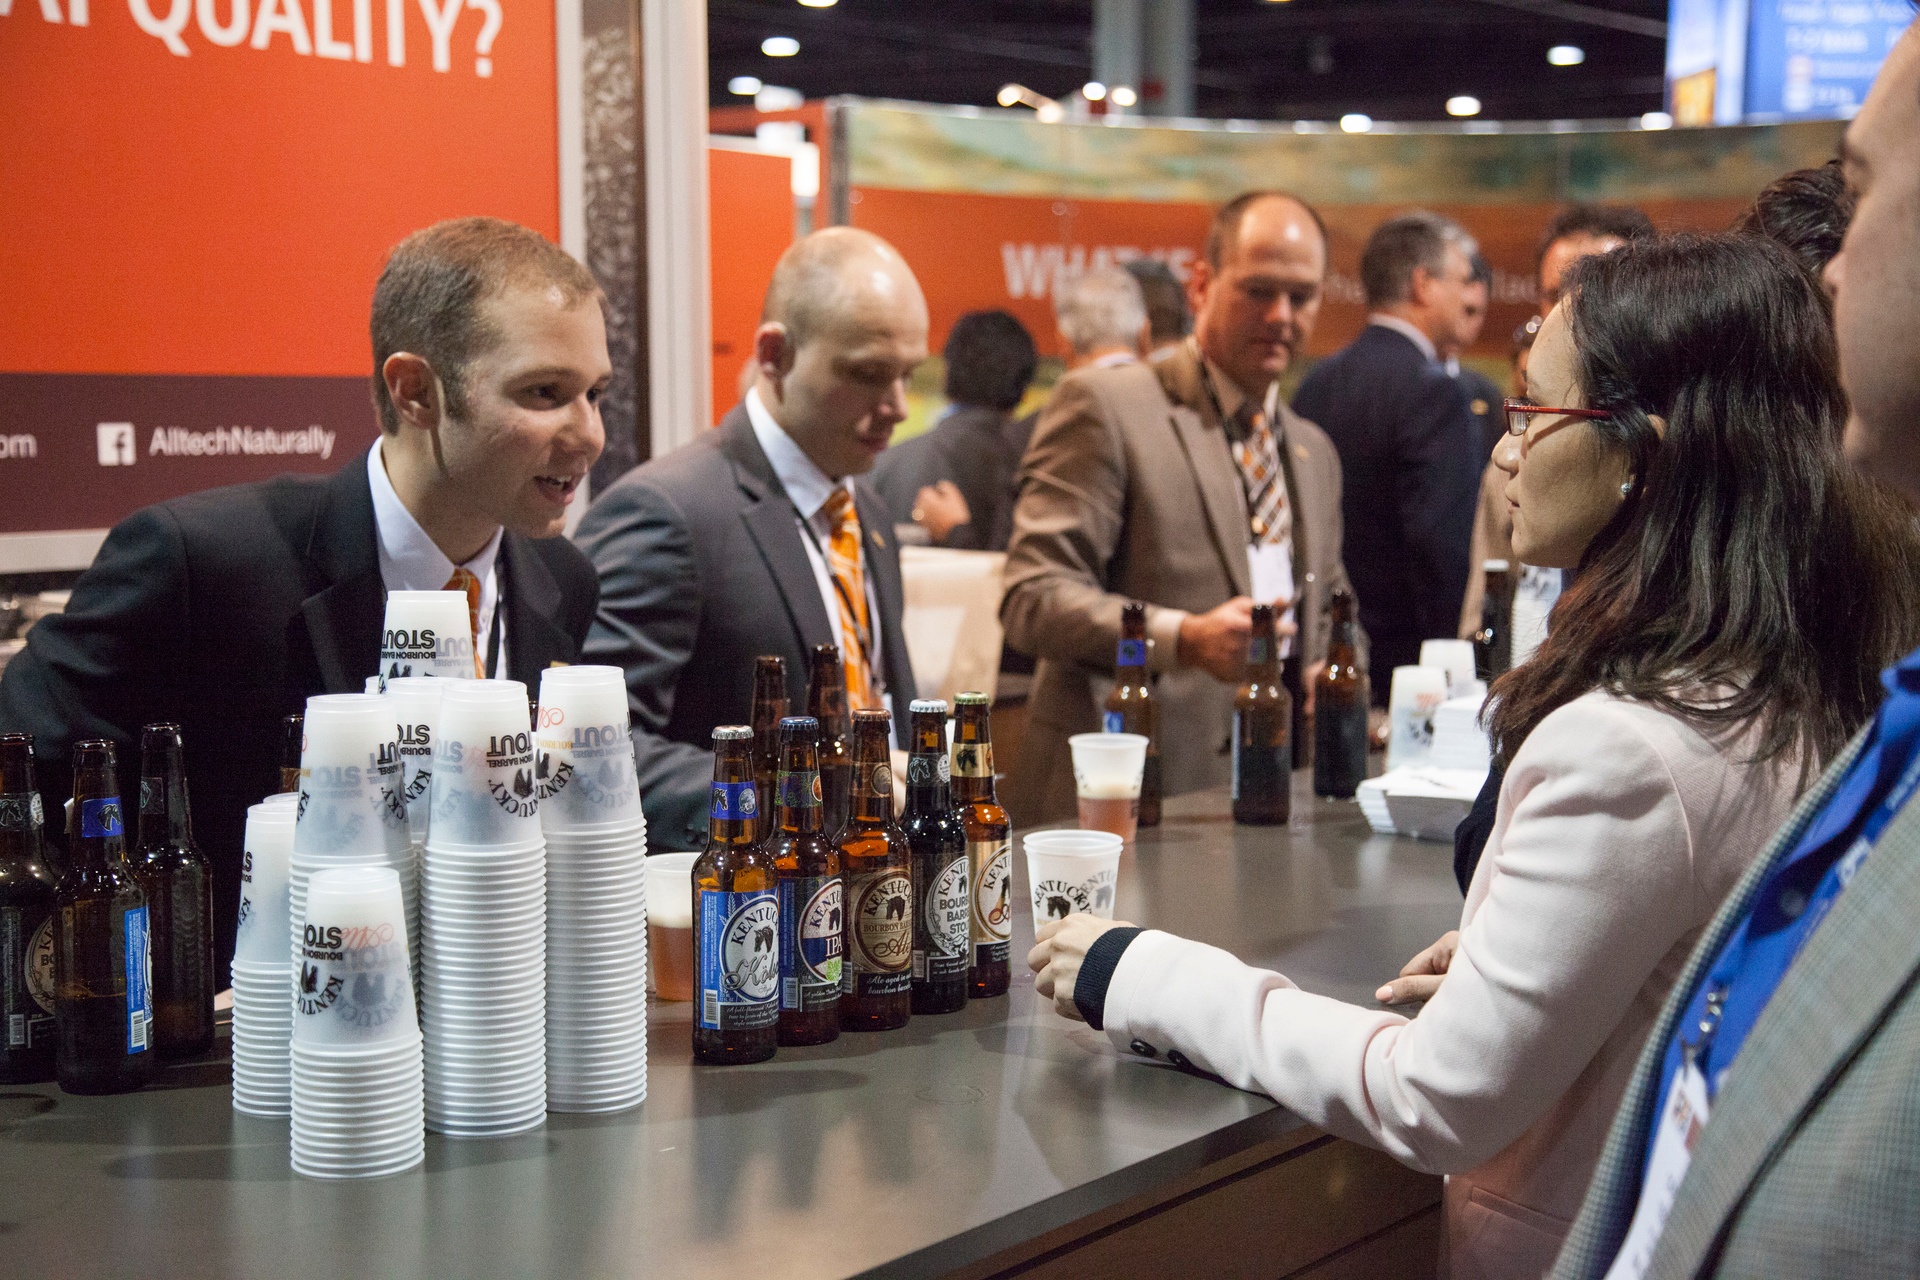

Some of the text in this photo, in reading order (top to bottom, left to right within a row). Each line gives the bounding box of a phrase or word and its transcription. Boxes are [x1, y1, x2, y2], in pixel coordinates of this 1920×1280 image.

[126, 0, 503, 78] QUALITY?
[149, 424, 336, 460] AlltechNaturally
[396, 651, 436, 660] BOURBON
[399, 747, 431, 756] BOURB
[487, 731, 533, 758] TOUT
[487, 757, 521, 768] BARREL
[539, 761, 574, 800] KENT
[939, 861, 968, 896] KENT
[984, 855, 1010, 890] KENT
[810, 890, 842, 930] KENTU
[864, 880, 912, 917] KENTUC
[940, 895, 968, 910] BOUR
[731, 906, 779, 946] KENTUC
[863, 922, 899, 933] BOURBON
[946, 909, 968, 923] BAR
[949, 921, 968, 935] STO
[303, 924, 342, 949] STO
[298, 975, 344, 1016] KENTU
